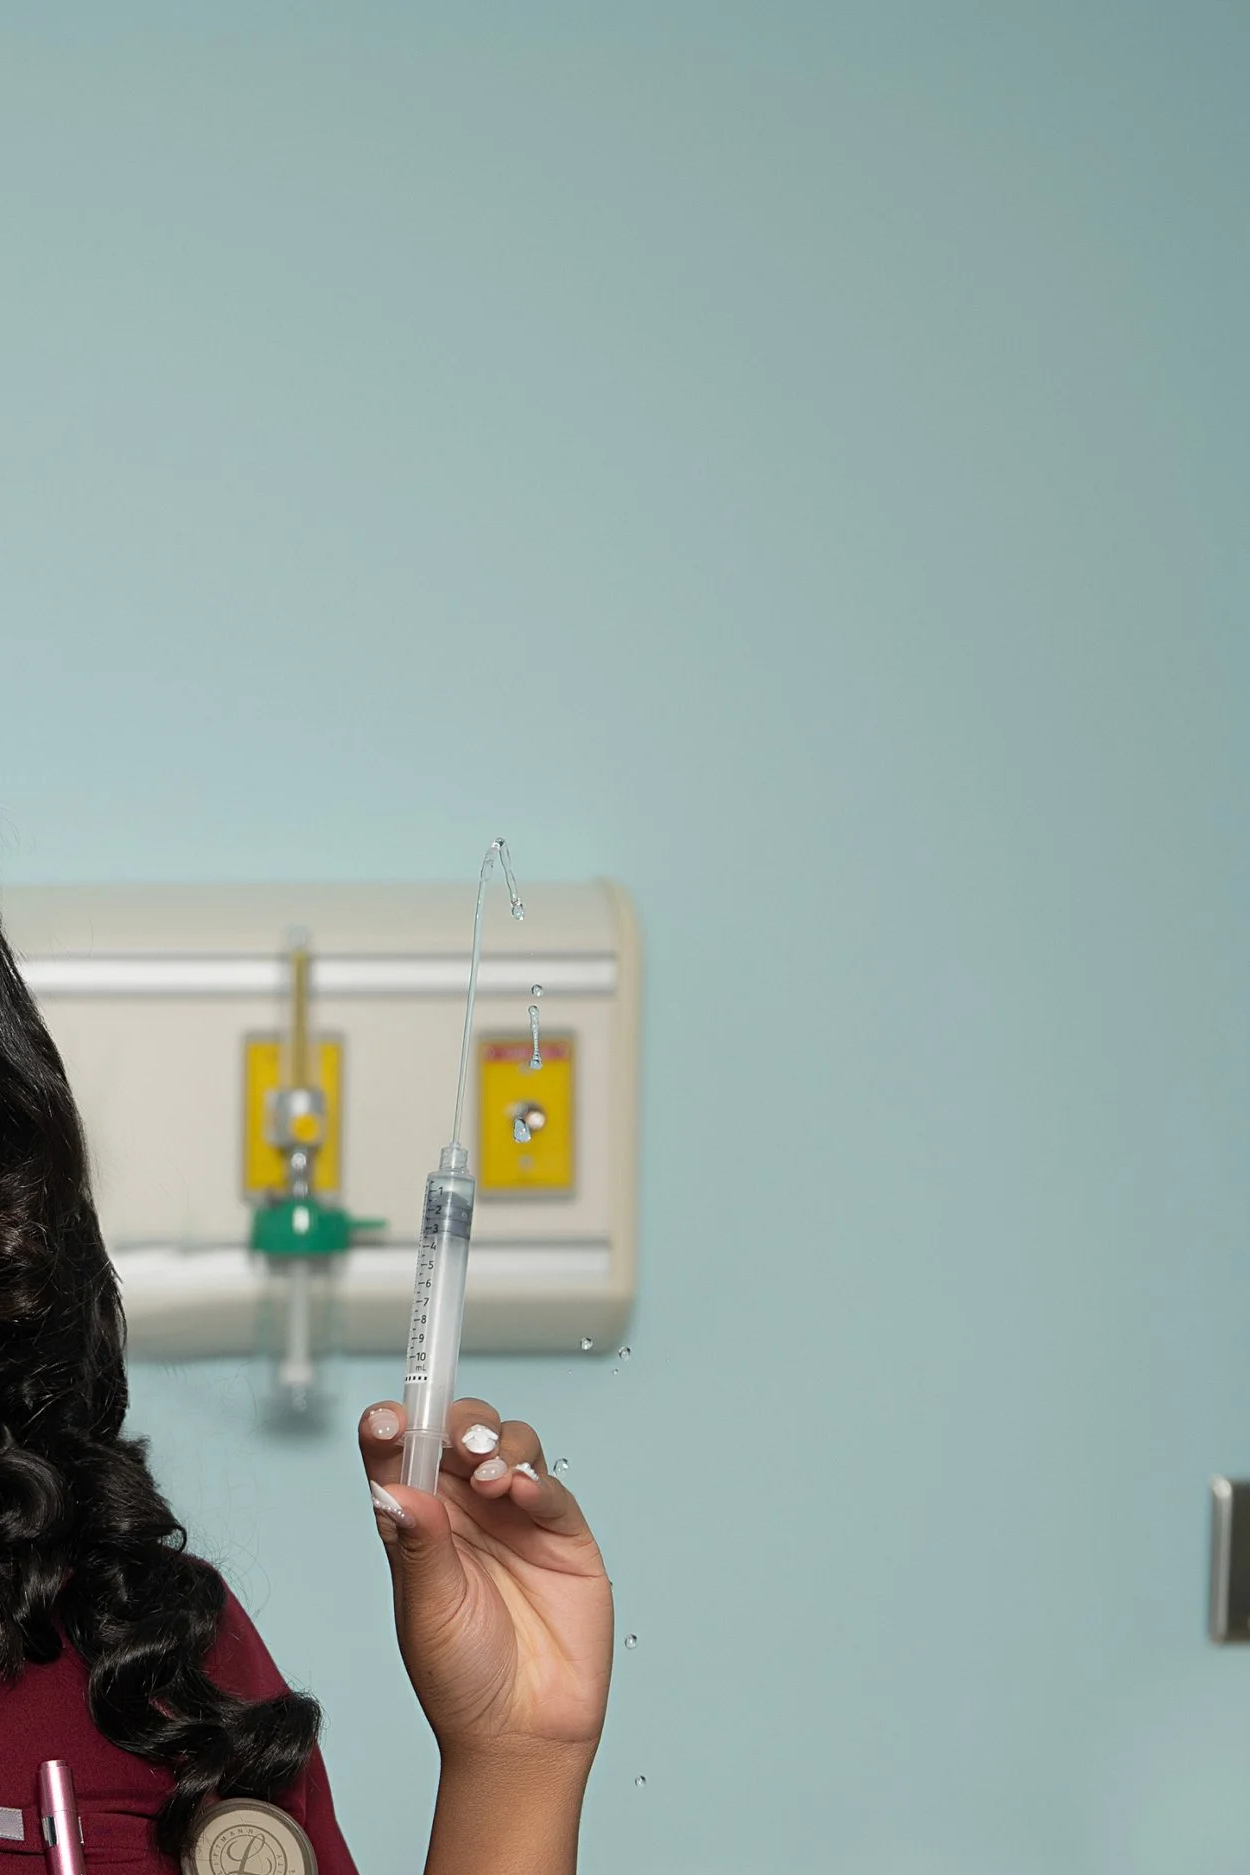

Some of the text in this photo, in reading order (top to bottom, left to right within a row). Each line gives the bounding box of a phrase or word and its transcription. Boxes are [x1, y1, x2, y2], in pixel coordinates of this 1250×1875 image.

[436, 1186, 443, 1196] 1
[434, 1205, 442, 1215] 2
[432, 1224, 439, 1233] 3
[430, 1242, 437, 1251] 4
[428, 1260, 434, 1269] 5
[425, 1279, 432, 1288] 6
[423, 1297, 430, 1307] 7
[420, 1314, 427, 1324] 8
[419, 1333, 425, 1343] 9
[416, 1352, 427, 1361] 10
[214, 1828, 253, 1875] LITTMANN
